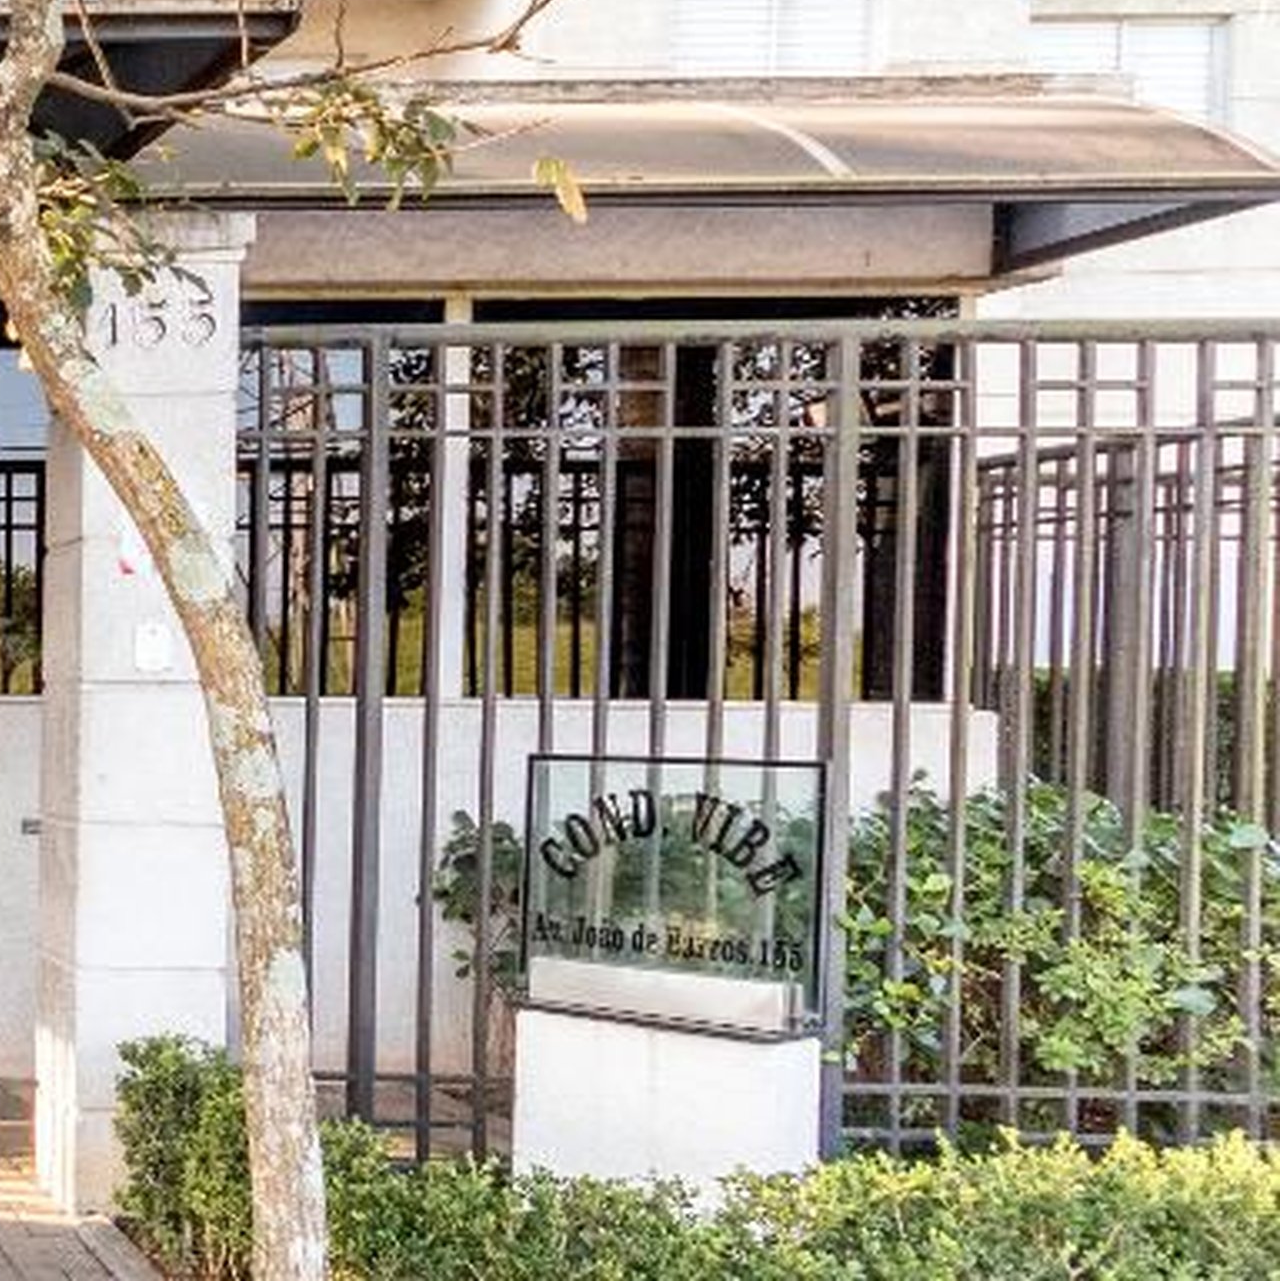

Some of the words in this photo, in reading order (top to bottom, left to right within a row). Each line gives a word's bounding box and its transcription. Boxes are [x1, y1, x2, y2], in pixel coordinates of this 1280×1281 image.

[108, 301, 217, 349] 155
[691, 791, 803, 897] VIBE
[632, 924, 659, 955] de
